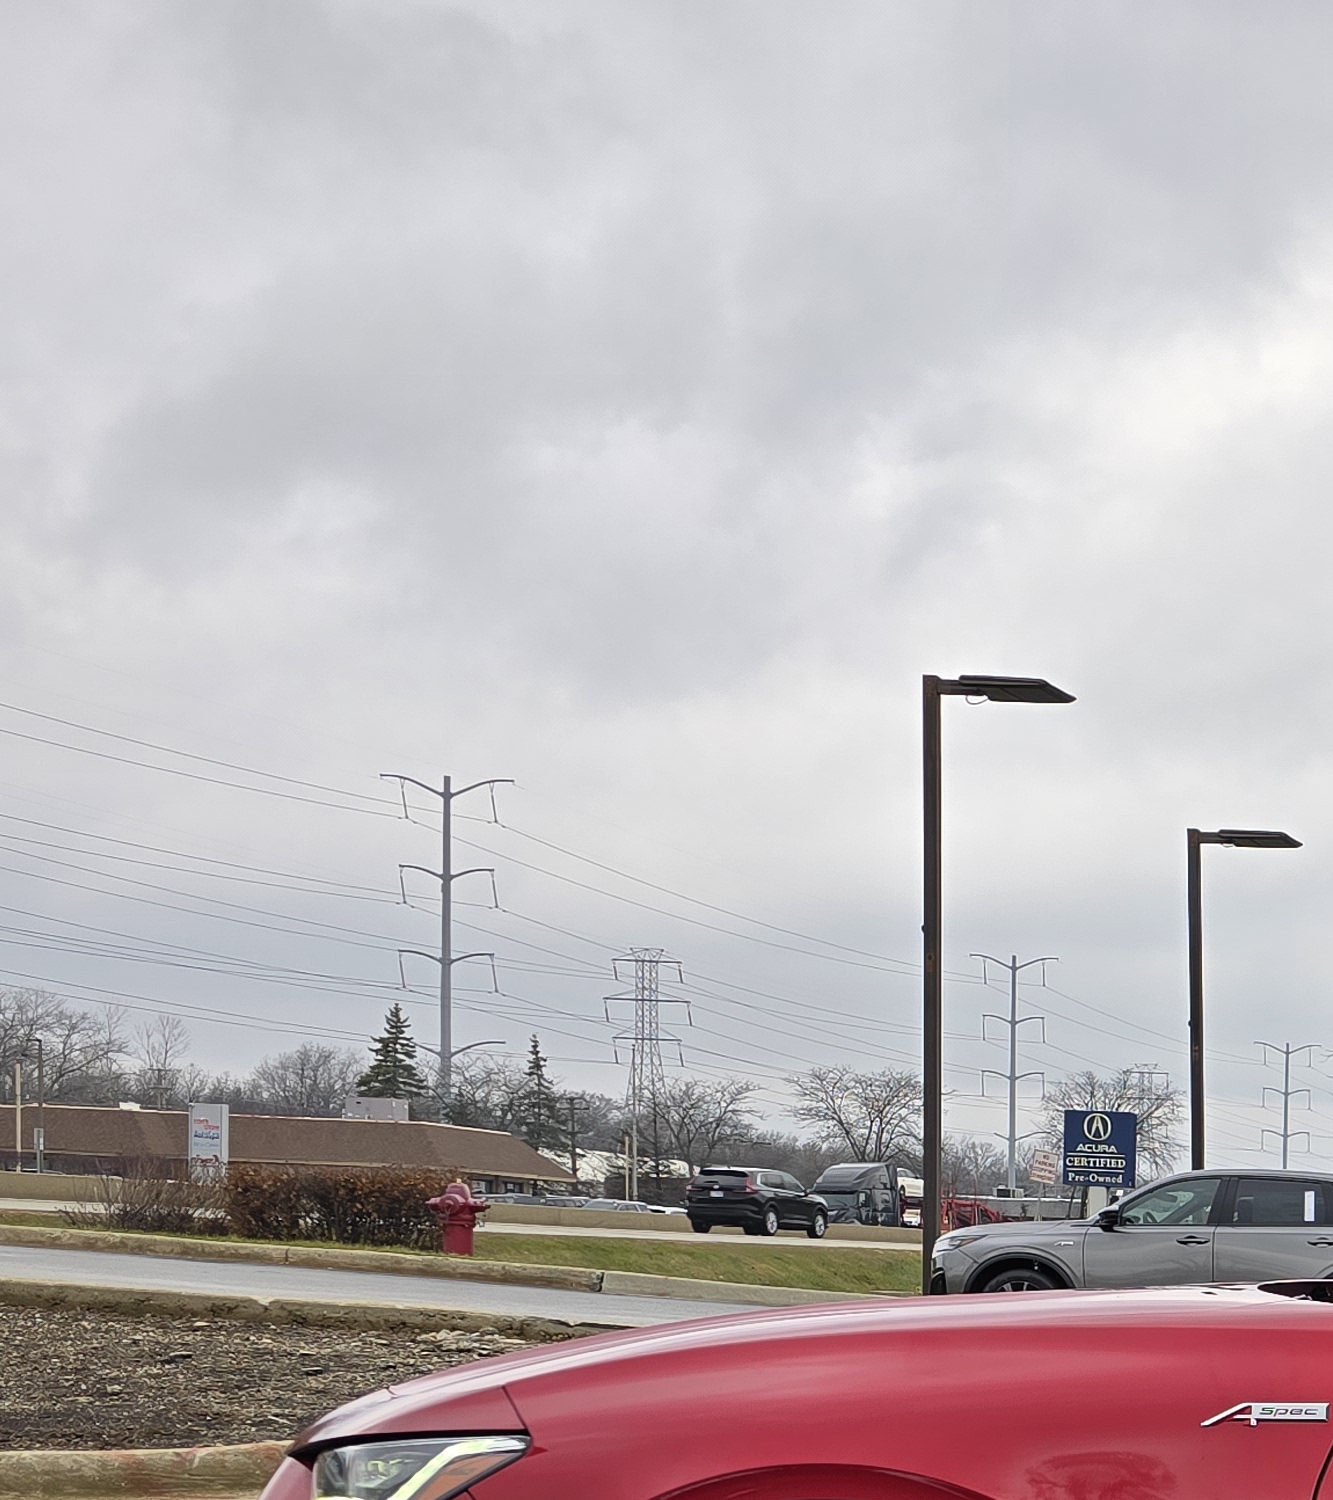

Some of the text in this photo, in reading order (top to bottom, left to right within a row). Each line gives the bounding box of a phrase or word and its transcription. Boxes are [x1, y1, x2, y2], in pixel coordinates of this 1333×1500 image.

[1076, 1144, 1117, 1153] ACURA
[1066, 1156, 1126, 1169] CERTIFIED
[1068, 1172, 1123, 1184] Pre-Owned
